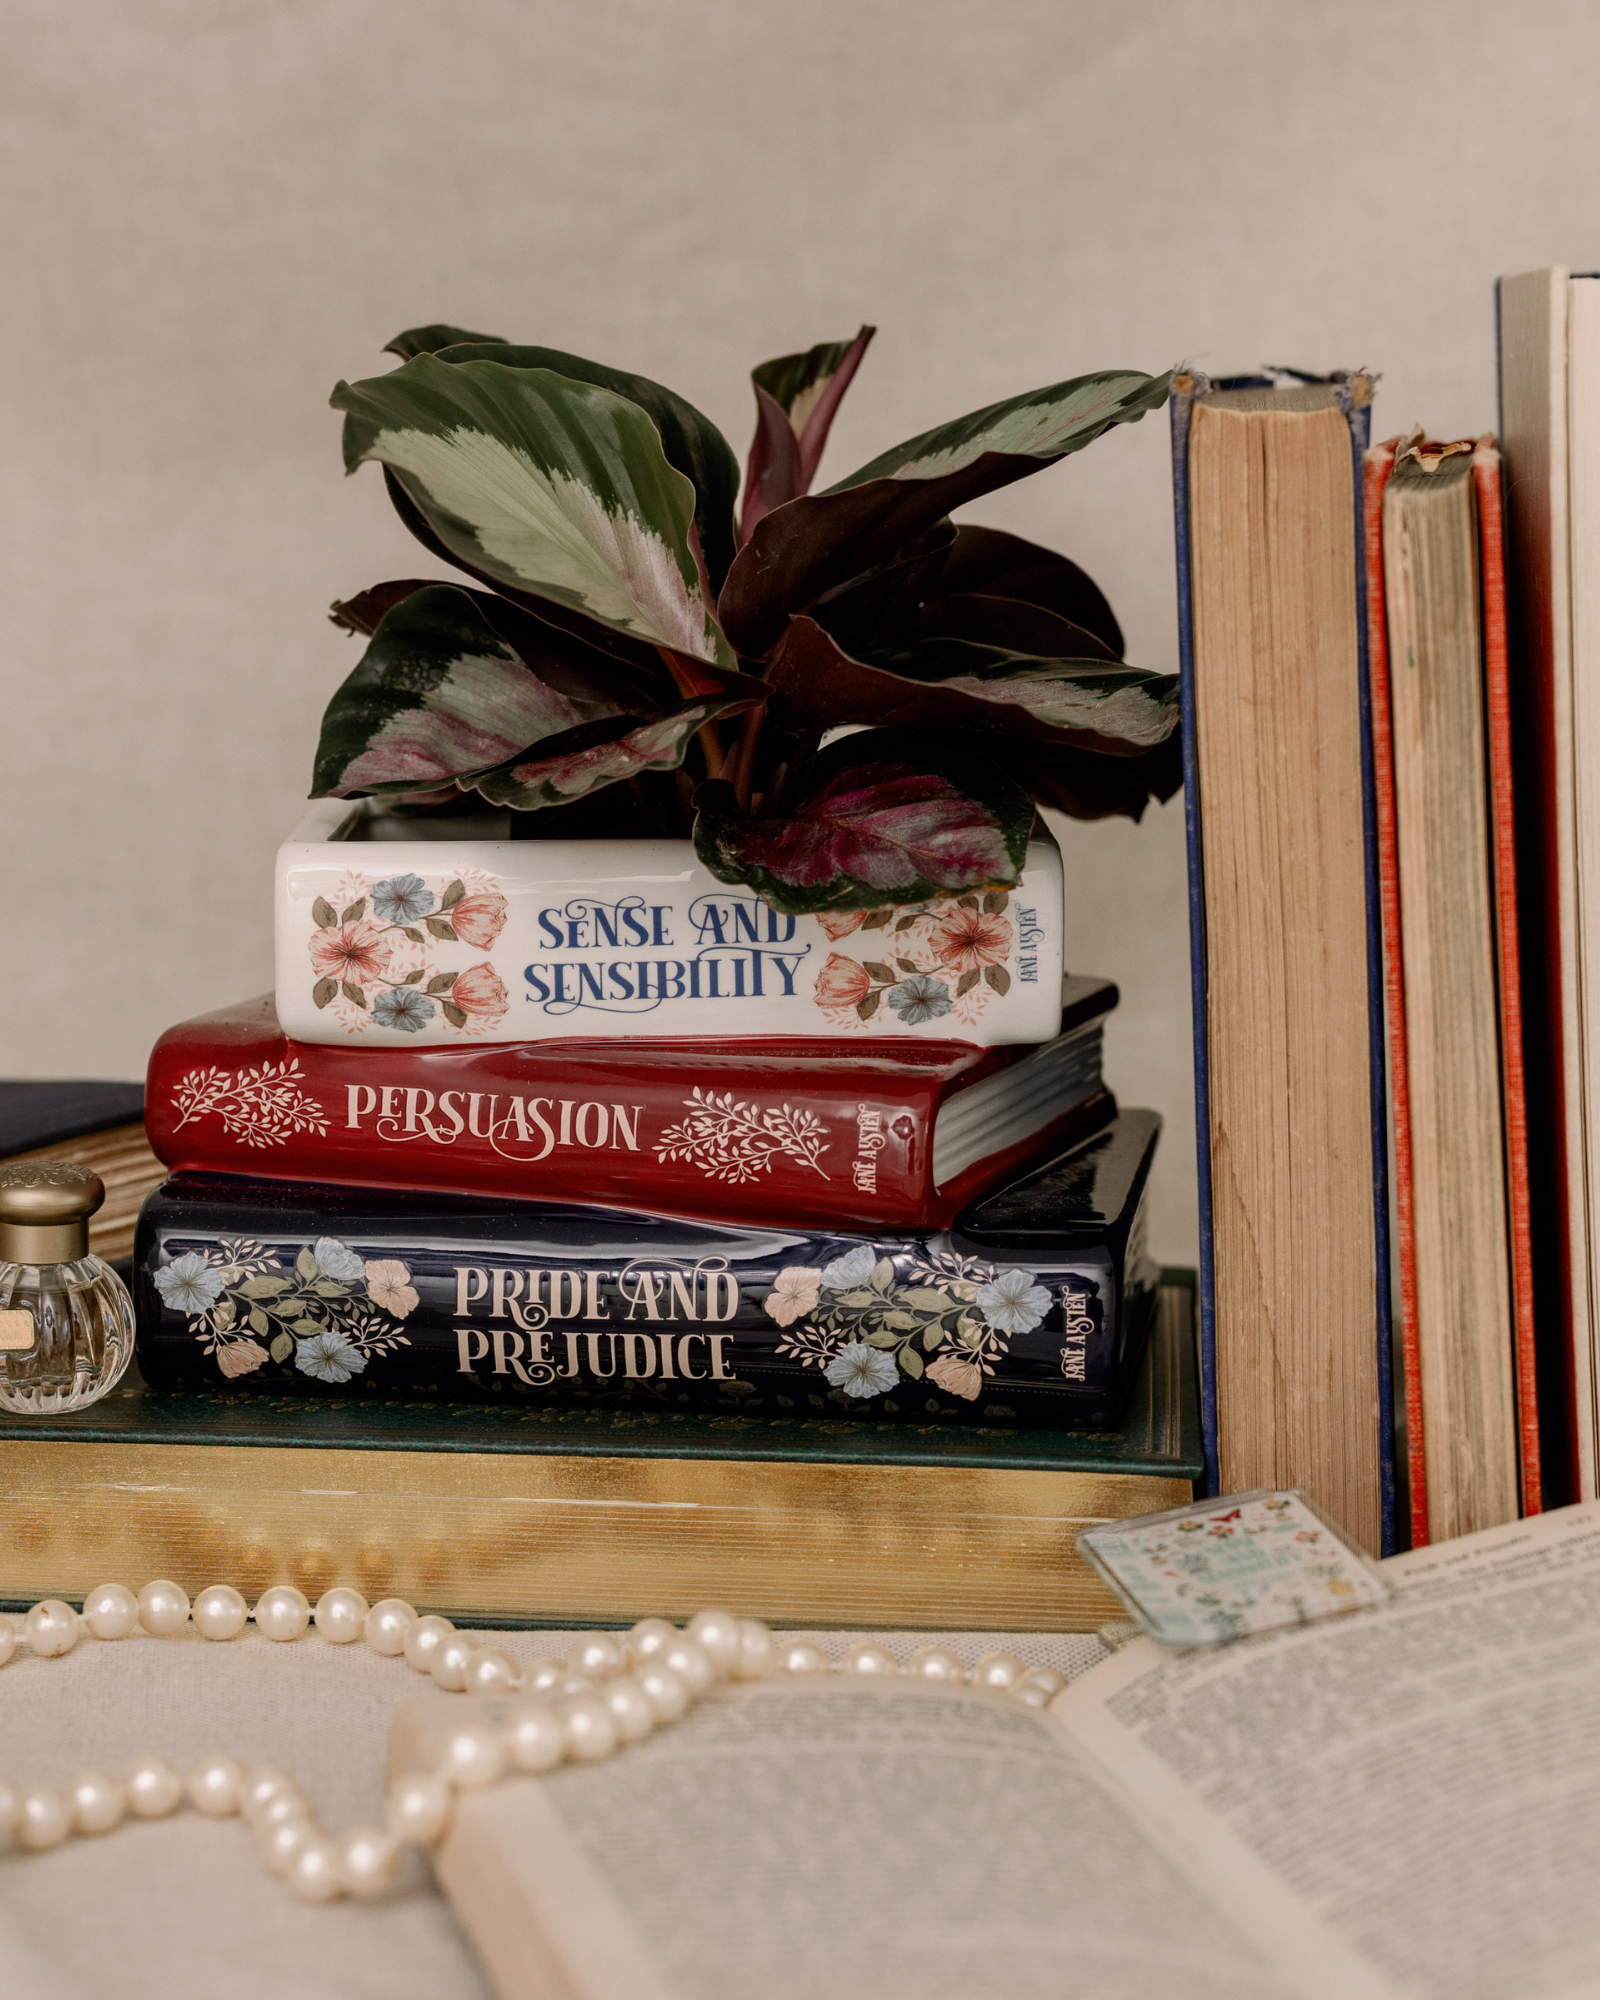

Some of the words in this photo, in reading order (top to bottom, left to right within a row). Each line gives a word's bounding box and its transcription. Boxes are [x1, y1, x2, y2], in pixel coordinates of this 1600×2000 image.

[537, 895, 675, 949] SENSE
[688, 893, 797, 946] AND
[1014, 902, 1046, 952] AUSTEN
[523, 943, 812, 1016] SENSIBILITY
[1014, 955, 1039, 984] JANE
[344, 1084, 644, 1161] PERSUASION
[856, 1103, 886, 1160] AUSTEN
[852, 1161, 878, 1195] JANE
[452, 1266, 611, 1331] PRIDE
[618, 1256, 739, 1322] AND
[1062, 1285, 1095, 1346] AUSTEN
[452, 1329, 737, 1386] PREJUDICE
[1060, 1347, 1086, 1382] JANE
